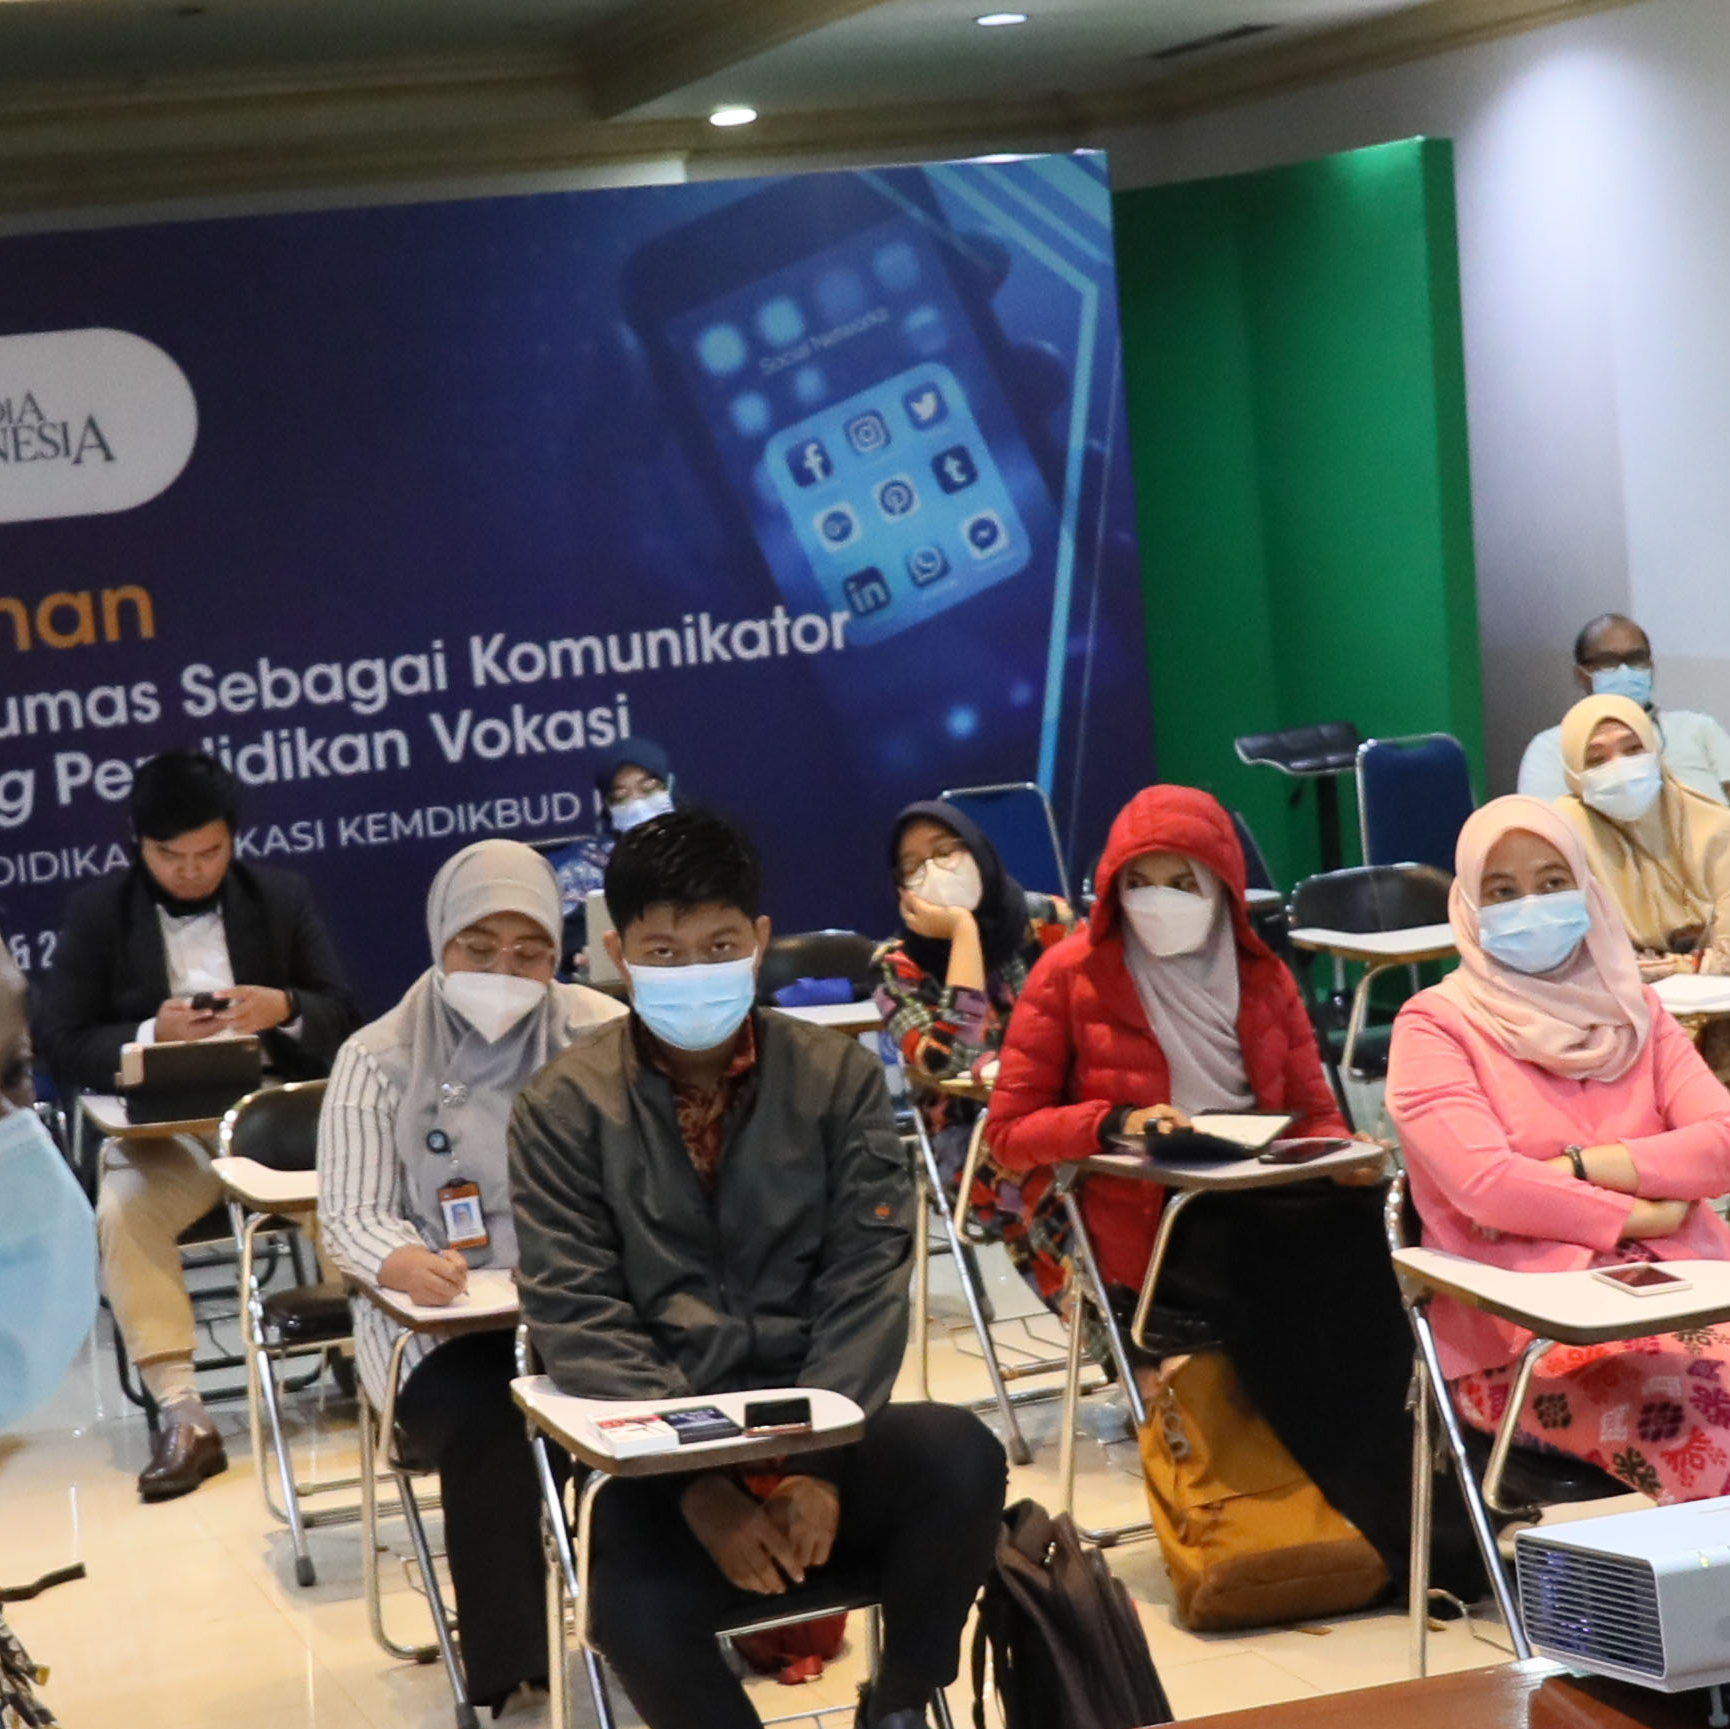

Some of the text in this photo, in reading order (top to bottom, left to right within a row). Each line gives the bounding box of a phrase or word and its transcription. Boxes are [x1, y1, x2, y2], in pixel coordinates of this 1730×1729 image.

[180, 639, 449, 716] Sebagai
[470, 604, 851, 687] Komunikator
[53, 725, 411, 807] Peidikan
[429, 693, 631, 764] Vokasi
[233, 819, 325, 859] KASI
[338, 791, 583, 849] KEMDIKBUD
